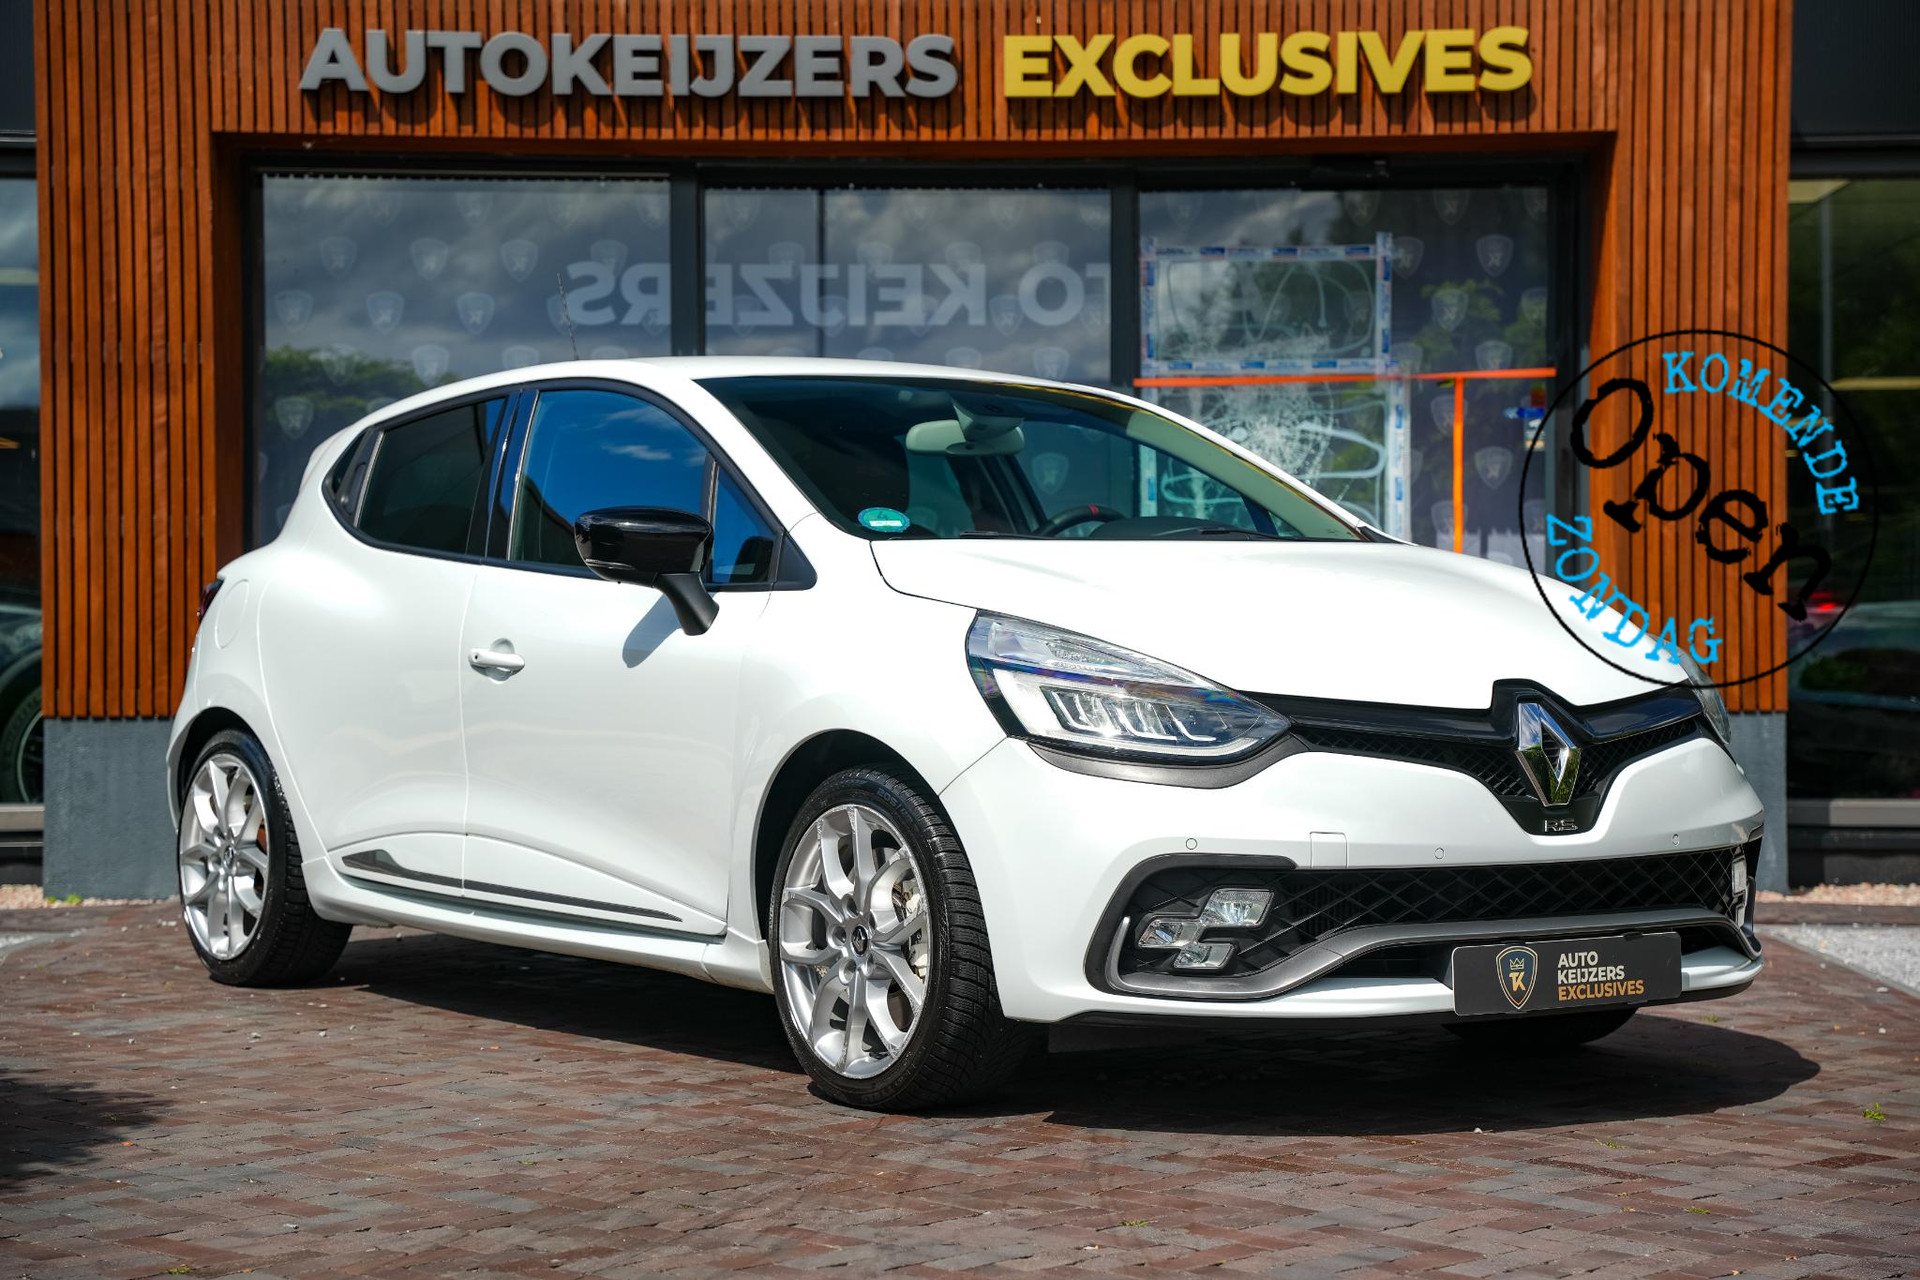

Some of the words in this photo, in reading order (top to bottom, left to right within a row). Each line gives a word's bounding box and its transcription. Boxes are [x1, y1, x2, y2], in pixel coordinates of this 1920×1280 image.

[298, 27, 960, 98] AUTOKEIJZERS
[1003, 26, 1533, 98] EXCLUSIVES
[1557, 950, 1599, 968] AUTO
[1557, 965, 1625, 985] KEIJZERS
[1558, 979, 1645, 1001] EXCLUSIVES
